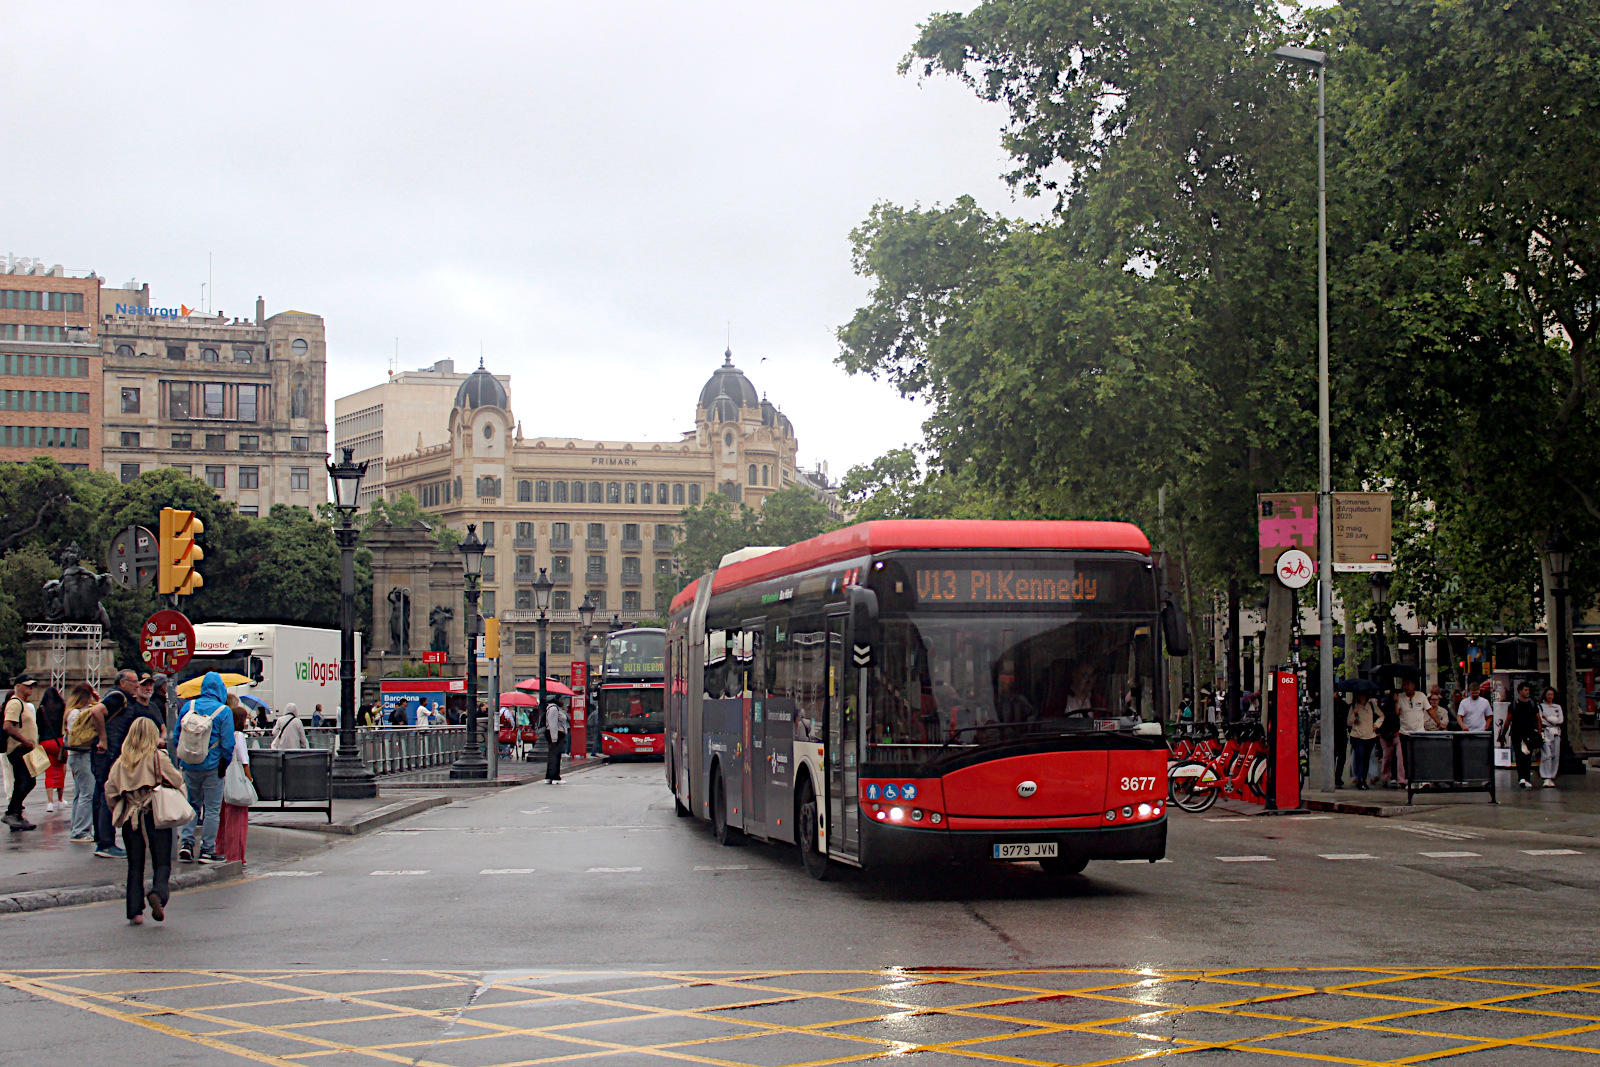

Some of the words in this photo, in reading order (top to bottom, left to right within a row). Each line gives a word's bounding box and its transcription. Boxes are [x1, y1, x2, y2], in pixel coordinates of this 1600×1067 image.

[115, 303, 178, 319] Naturgy
[591, 457, 638, 466] PRIMARK
[1336, 506, 1382, 514] d'Arquitectura
[916, 570, 957, 599] V13
[970, 570, 1097, 600] Pl.Kennedy
[295, 656, 340, 687] vailogisti
[624, 663, 641, 672] RUTA
[643, 662, 664, 672] VERDA
[1120, 777, 1156, 791] 3677
[1002, 845, 1030, 856] 9779
[1034, 844, 1055, 856] JVN
